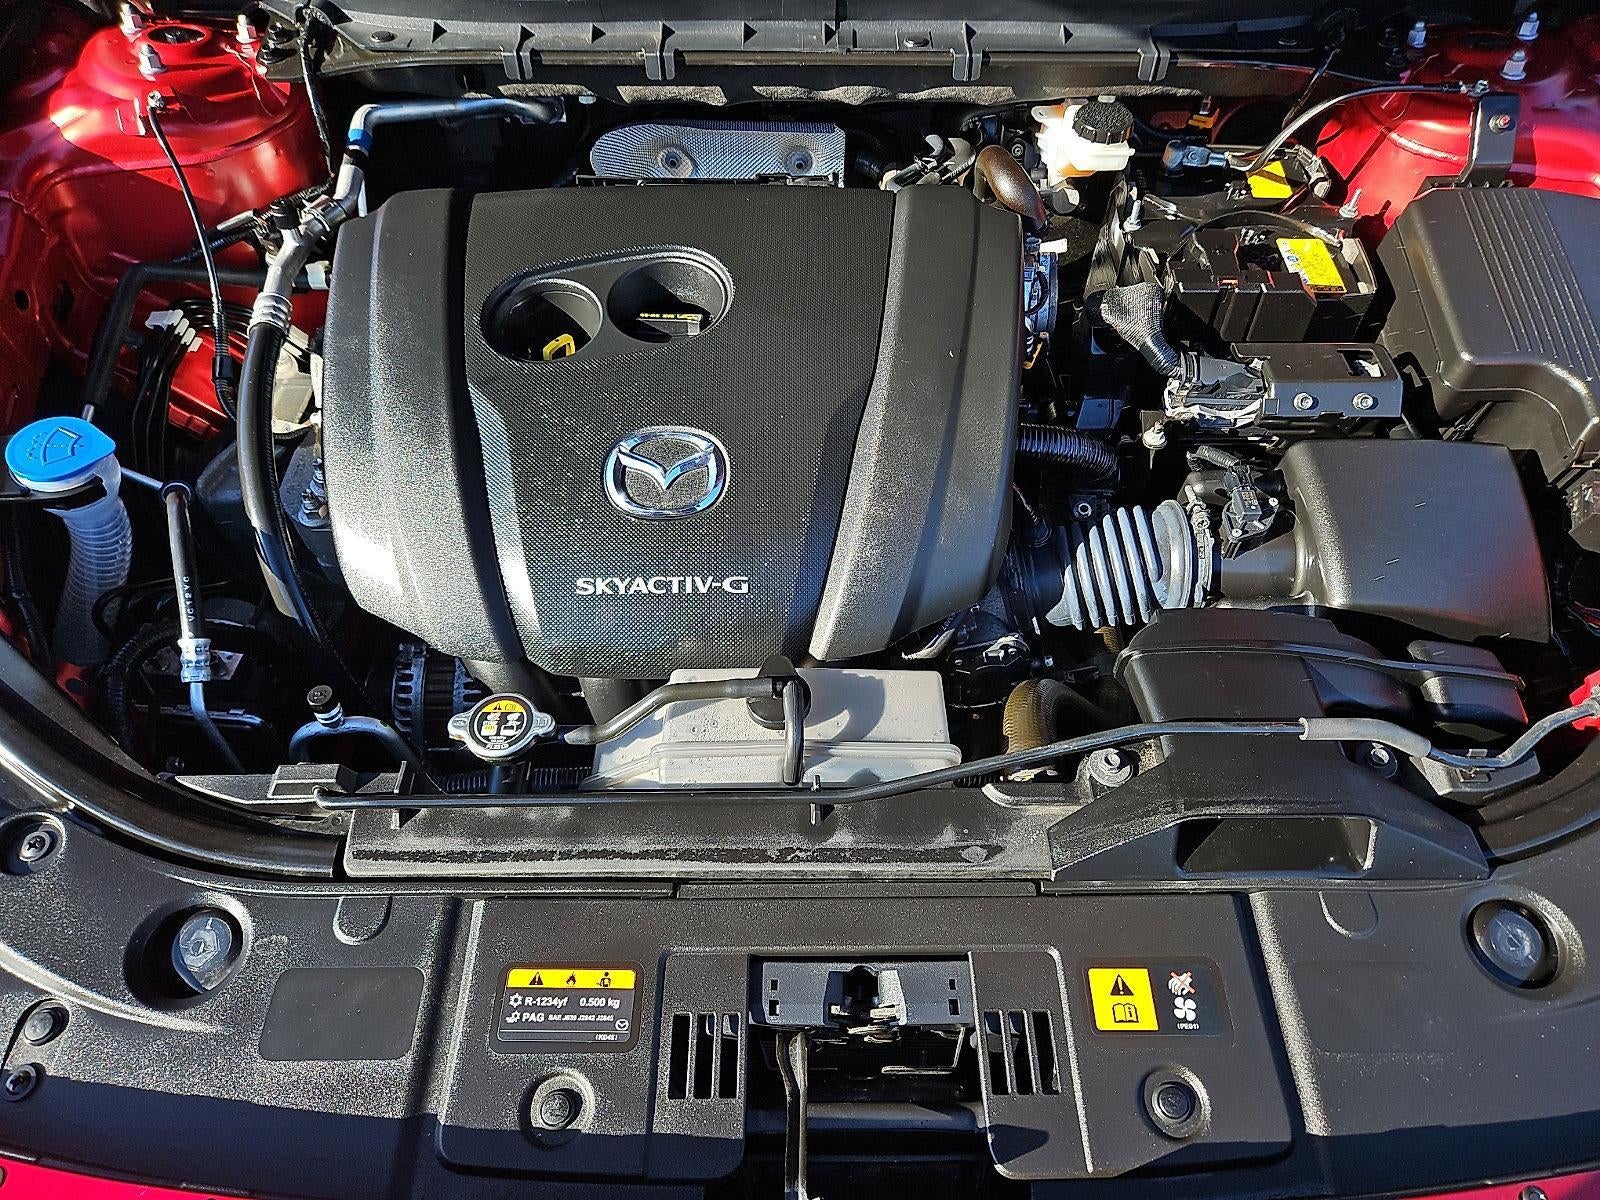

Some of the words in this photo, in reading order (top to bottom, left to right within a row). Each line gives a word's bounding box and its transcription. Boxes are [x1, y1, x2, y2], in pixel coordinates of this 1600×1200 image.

[575, 575, 750, 596] SKYACTIV-G
[524, 996, 568, 1008] R-1234yf
[579, 997, 606, 1007] 0.500
[607, 997, 620, 1009] kg
[522, 1012, 545, 1022] PAG
